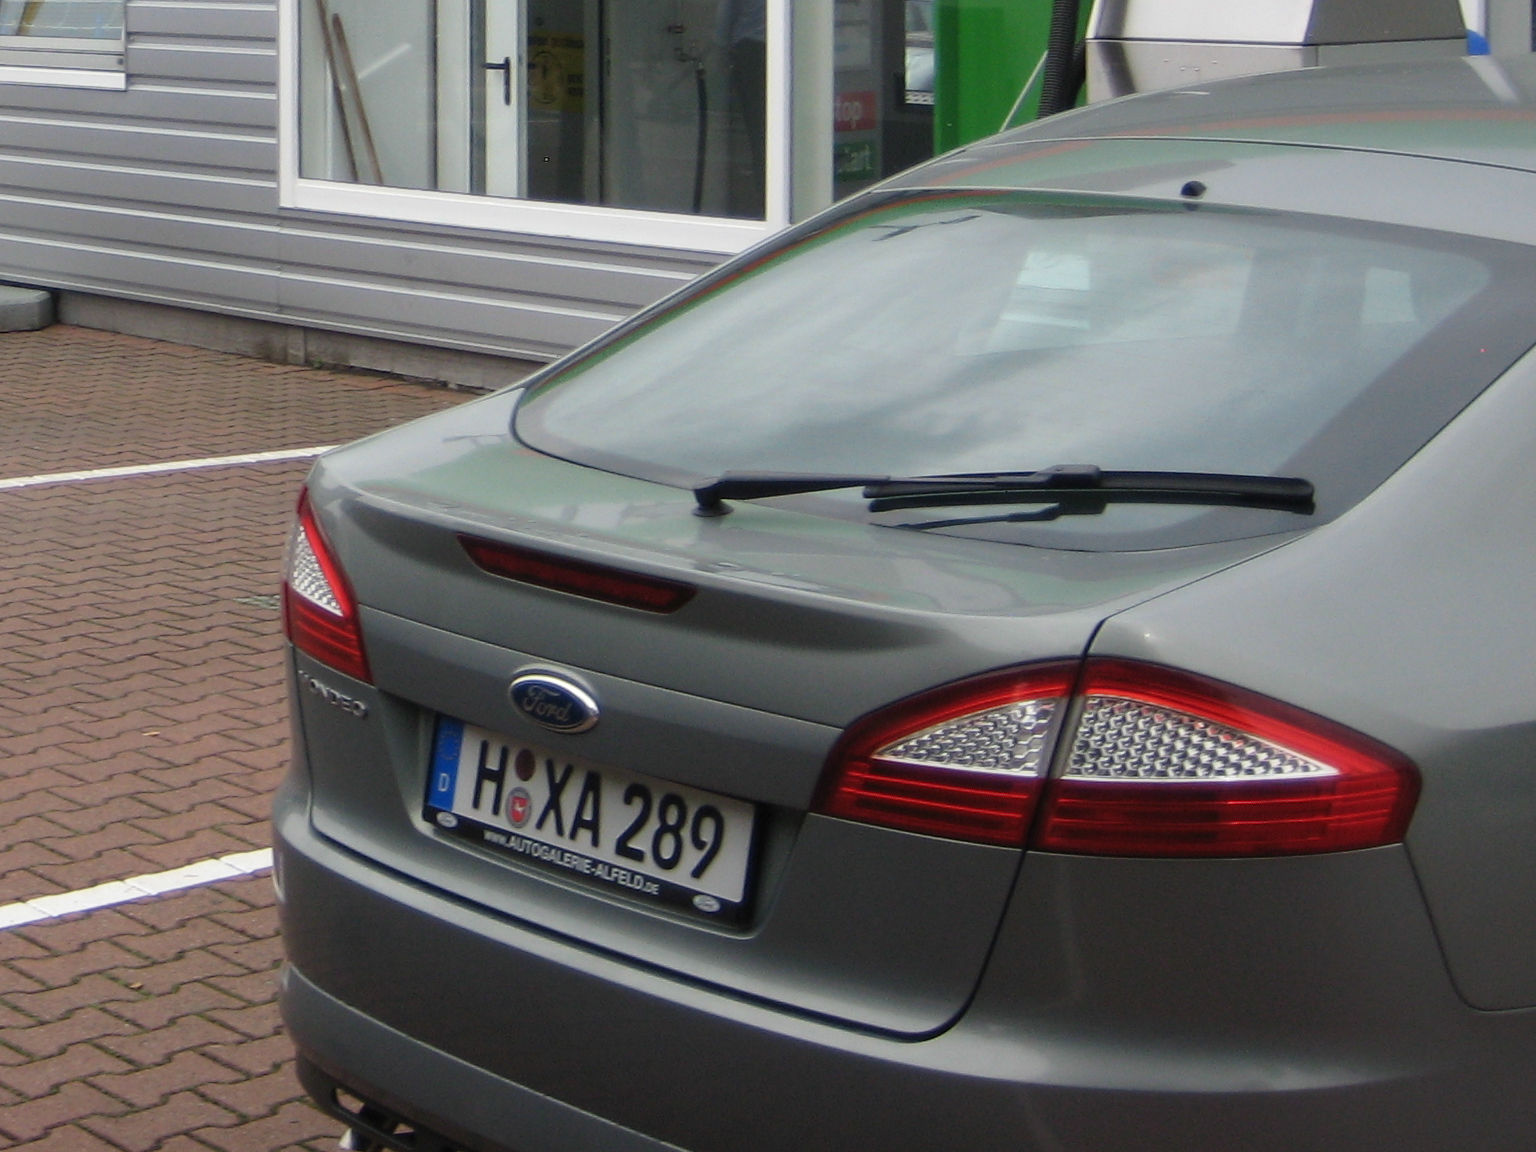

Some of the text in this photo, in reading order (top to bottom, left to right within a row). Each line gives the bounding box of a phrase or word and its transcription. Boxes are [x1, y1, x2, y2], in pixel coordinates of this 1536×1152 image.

[521, 684, 571, 724] Ford
[472, 739, 725, 879] H XA 289
